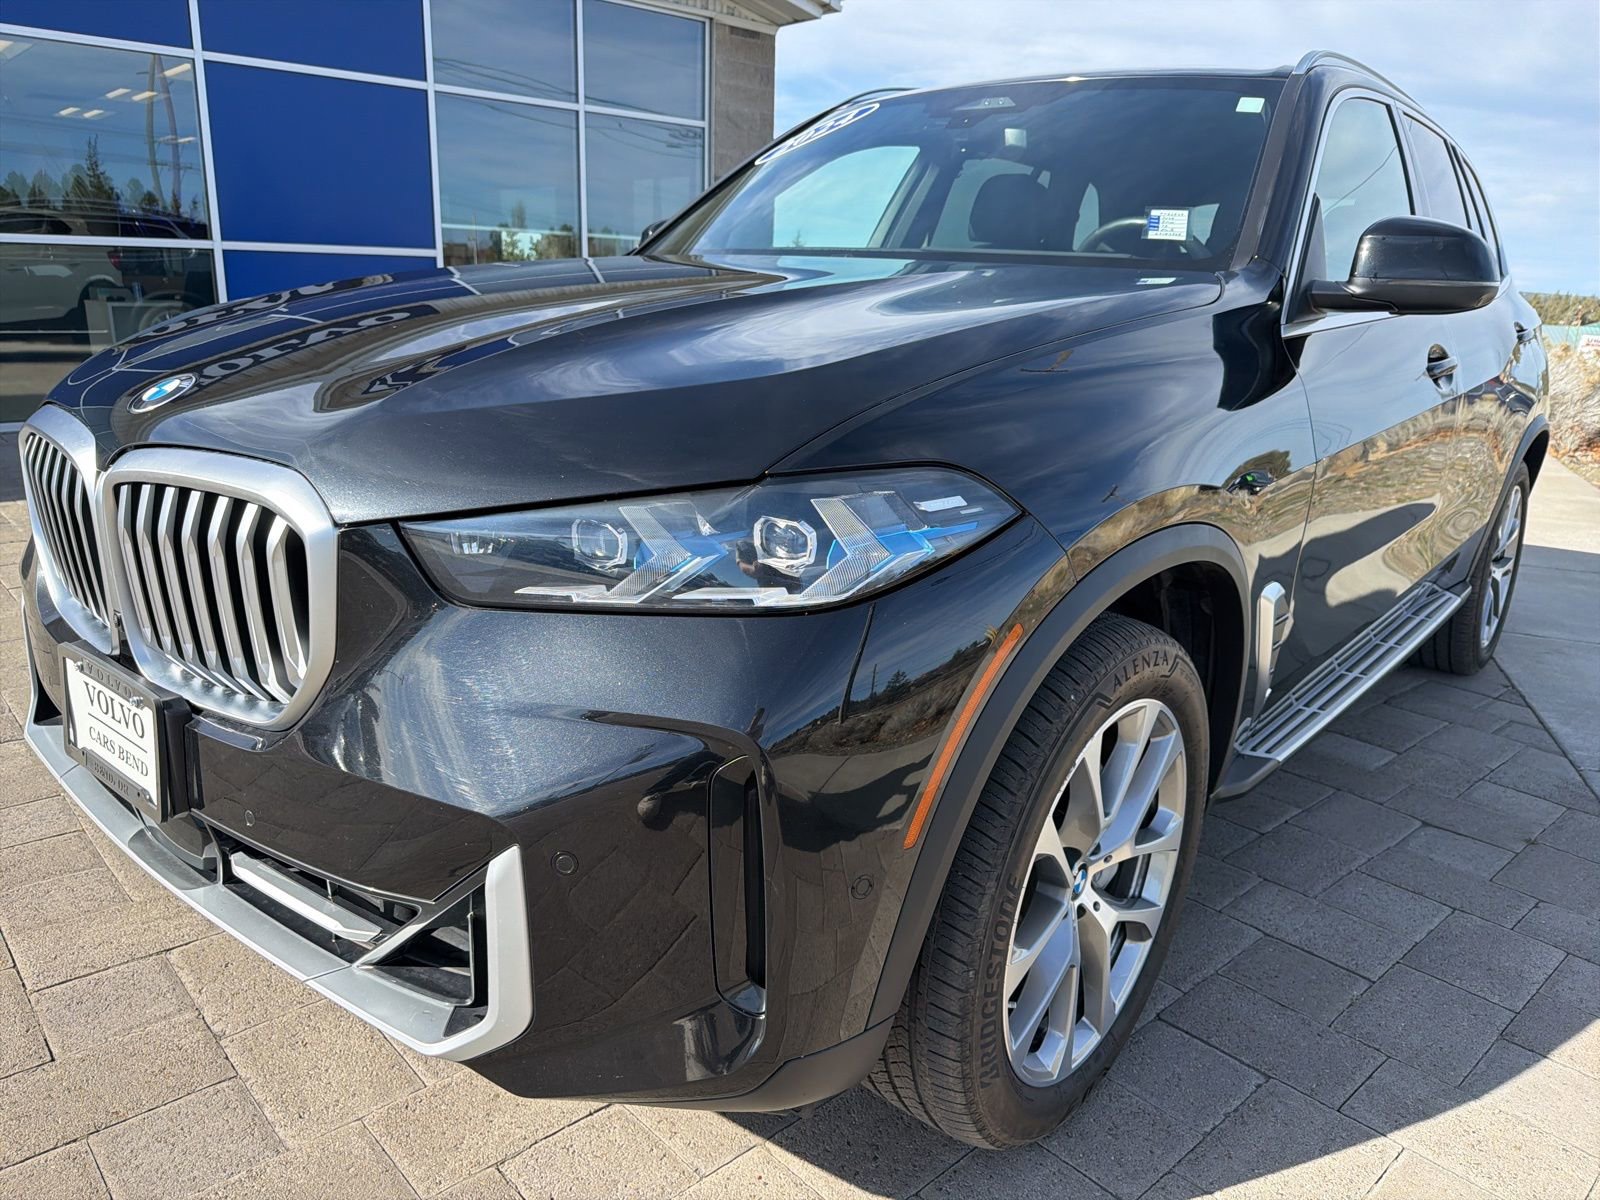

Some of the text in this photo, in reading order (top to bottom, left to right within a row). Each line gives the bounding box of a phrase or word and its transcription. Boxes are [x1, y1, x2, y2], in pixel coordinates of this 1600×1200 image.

[86, 661, 133, 698] VOLVO
[1112, 650, 1169, 693] ALENZA
[83, 680, 145, 739] VOLVO
[88, 726, 149, 777] CARS BEND
[979, 872, 1020, 1089] BRIDGESTONE
